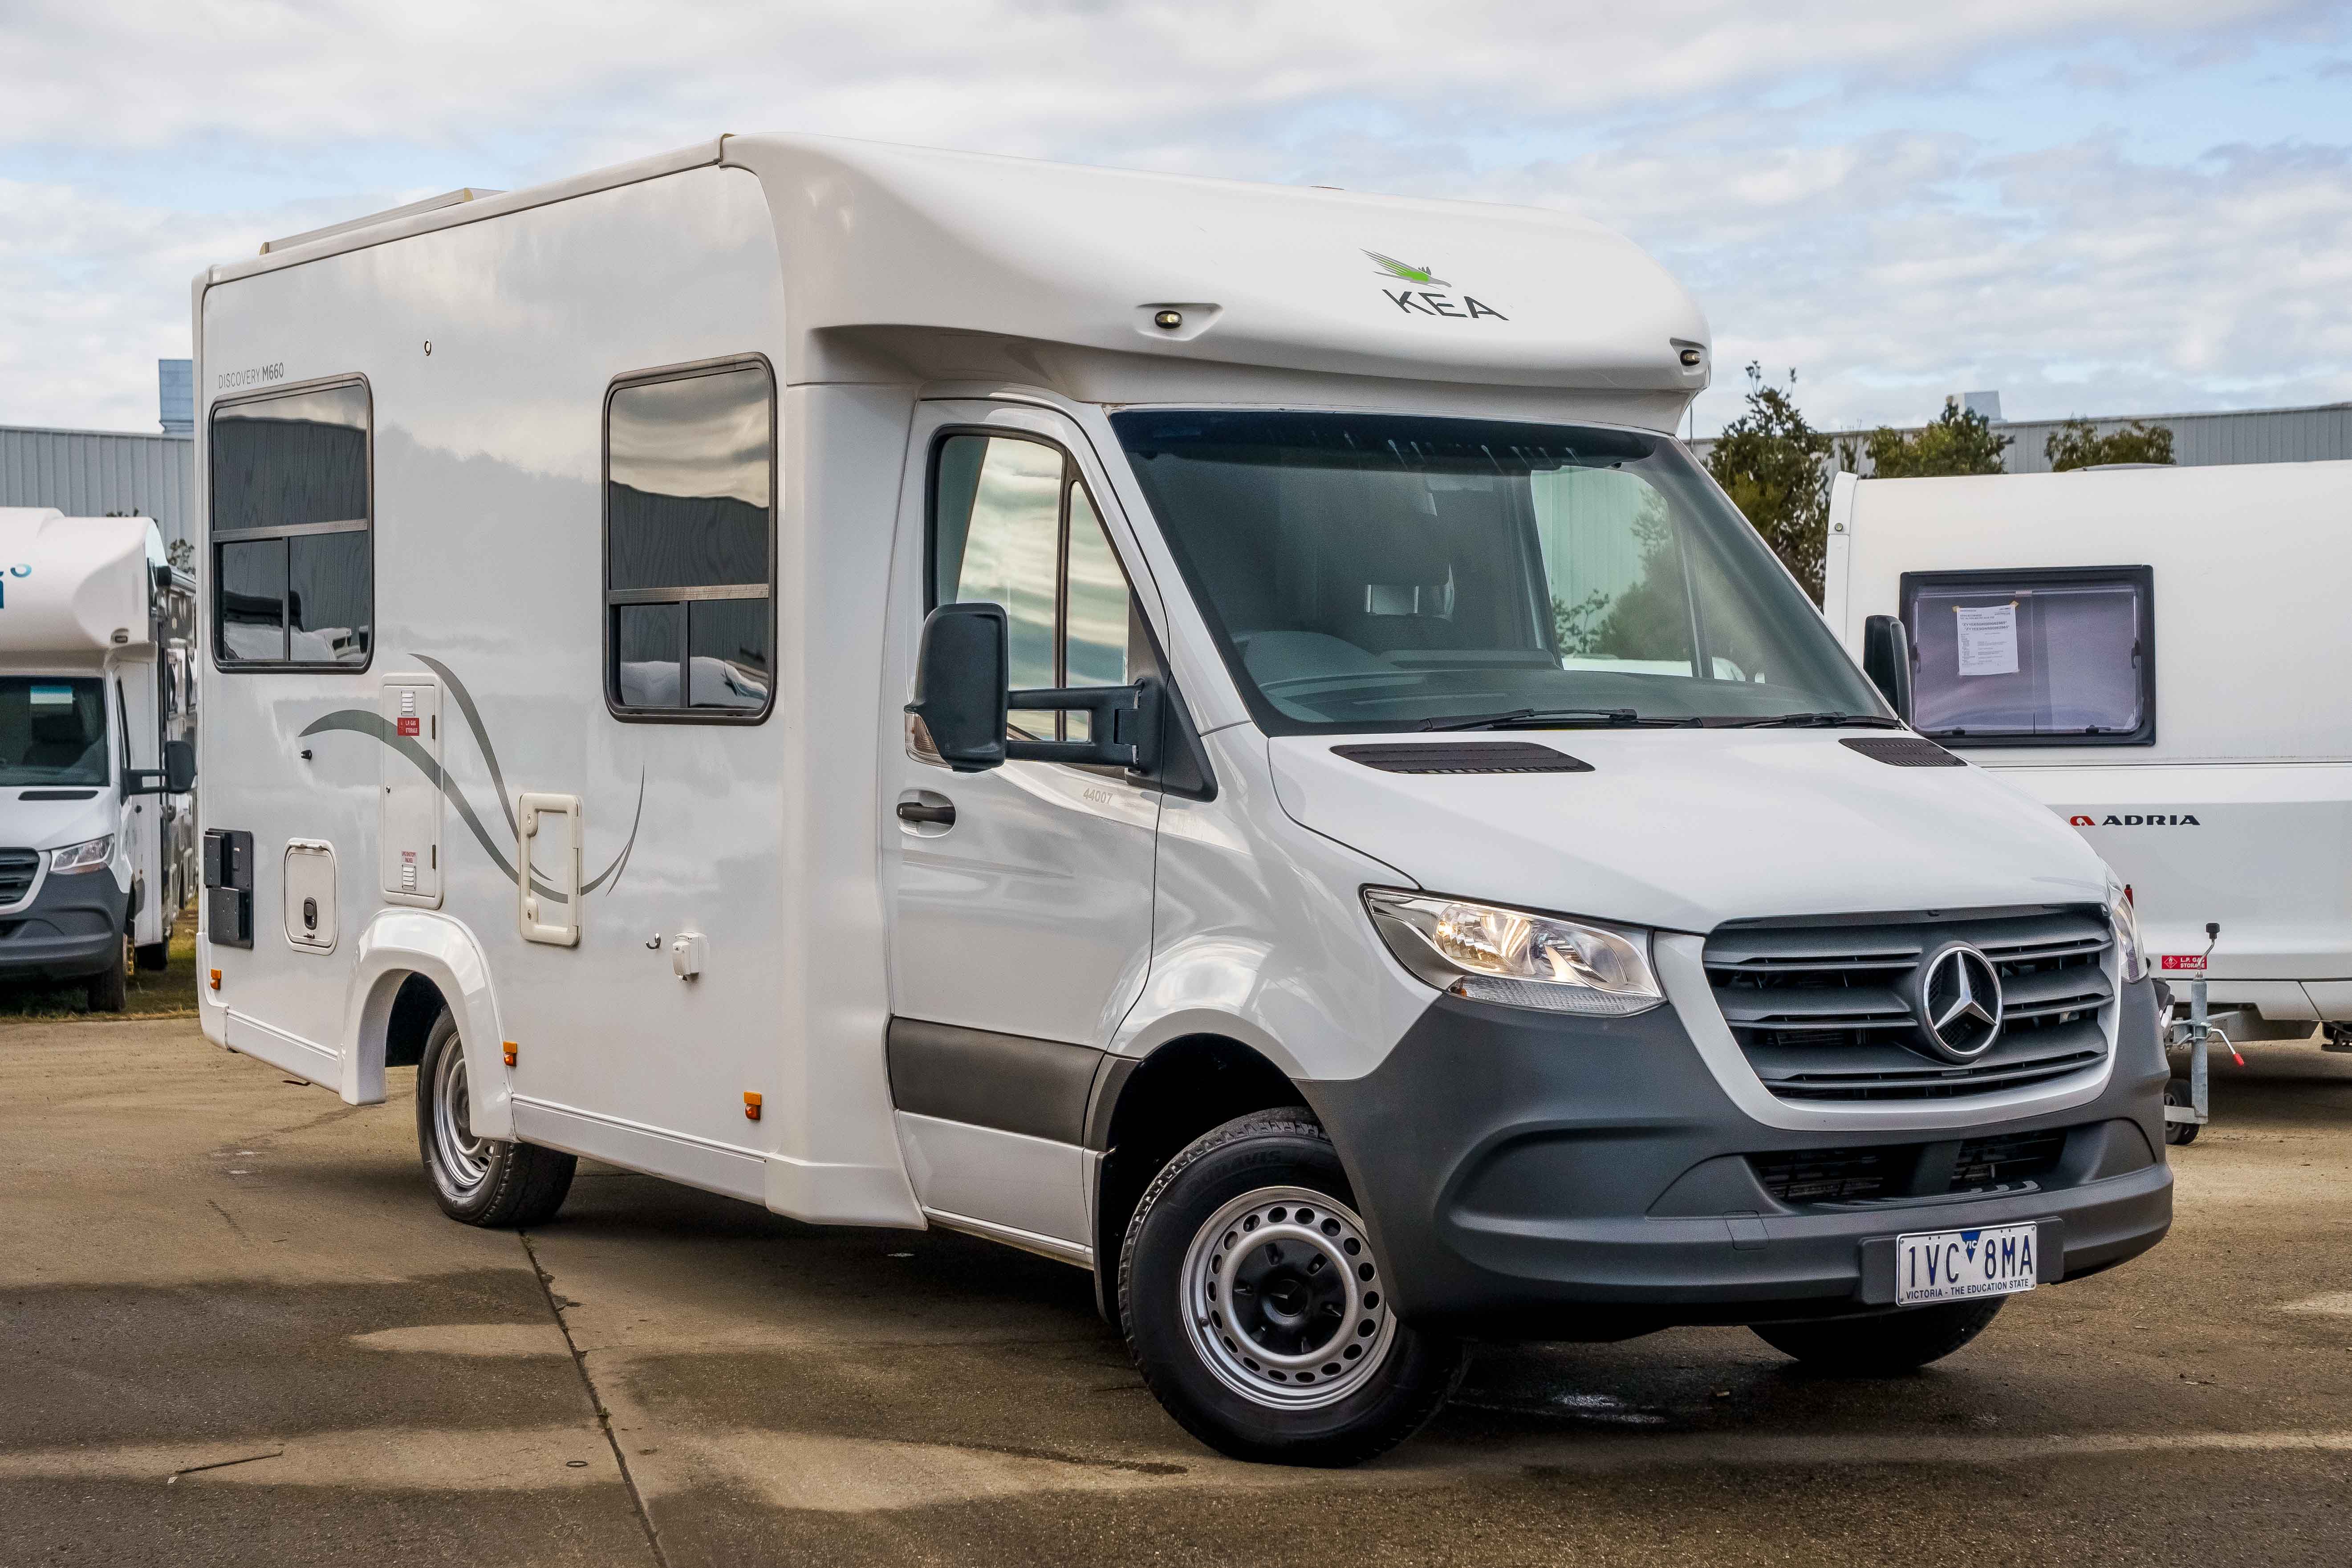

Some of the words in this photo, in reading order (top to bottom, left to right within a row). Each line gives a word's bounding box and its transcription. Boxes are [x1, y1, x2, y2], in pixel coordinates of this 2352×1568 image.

[1382, 289, 1510, 321] KEA
[218, 367, 260, 389] DISCOVERY
[262, 362, 284, 382] M660
[1083, 788, 1114, 805] 44007
[2102, 815, 2201, 825] ADRIA
[1963, 1240, 1977, 1249] VIC
[1909, 1242, 1959, 1288] 1VC
[1984, 1234, 2033, 1280] 8MA
[1906, 1288, 1943, 1300] VICTORIA
[1950, 1286, 1965, 1296] THE
[1967, 1282, 2007, 1294] EDUCATION
[2009, 1278, 2029, 1289] STATE
